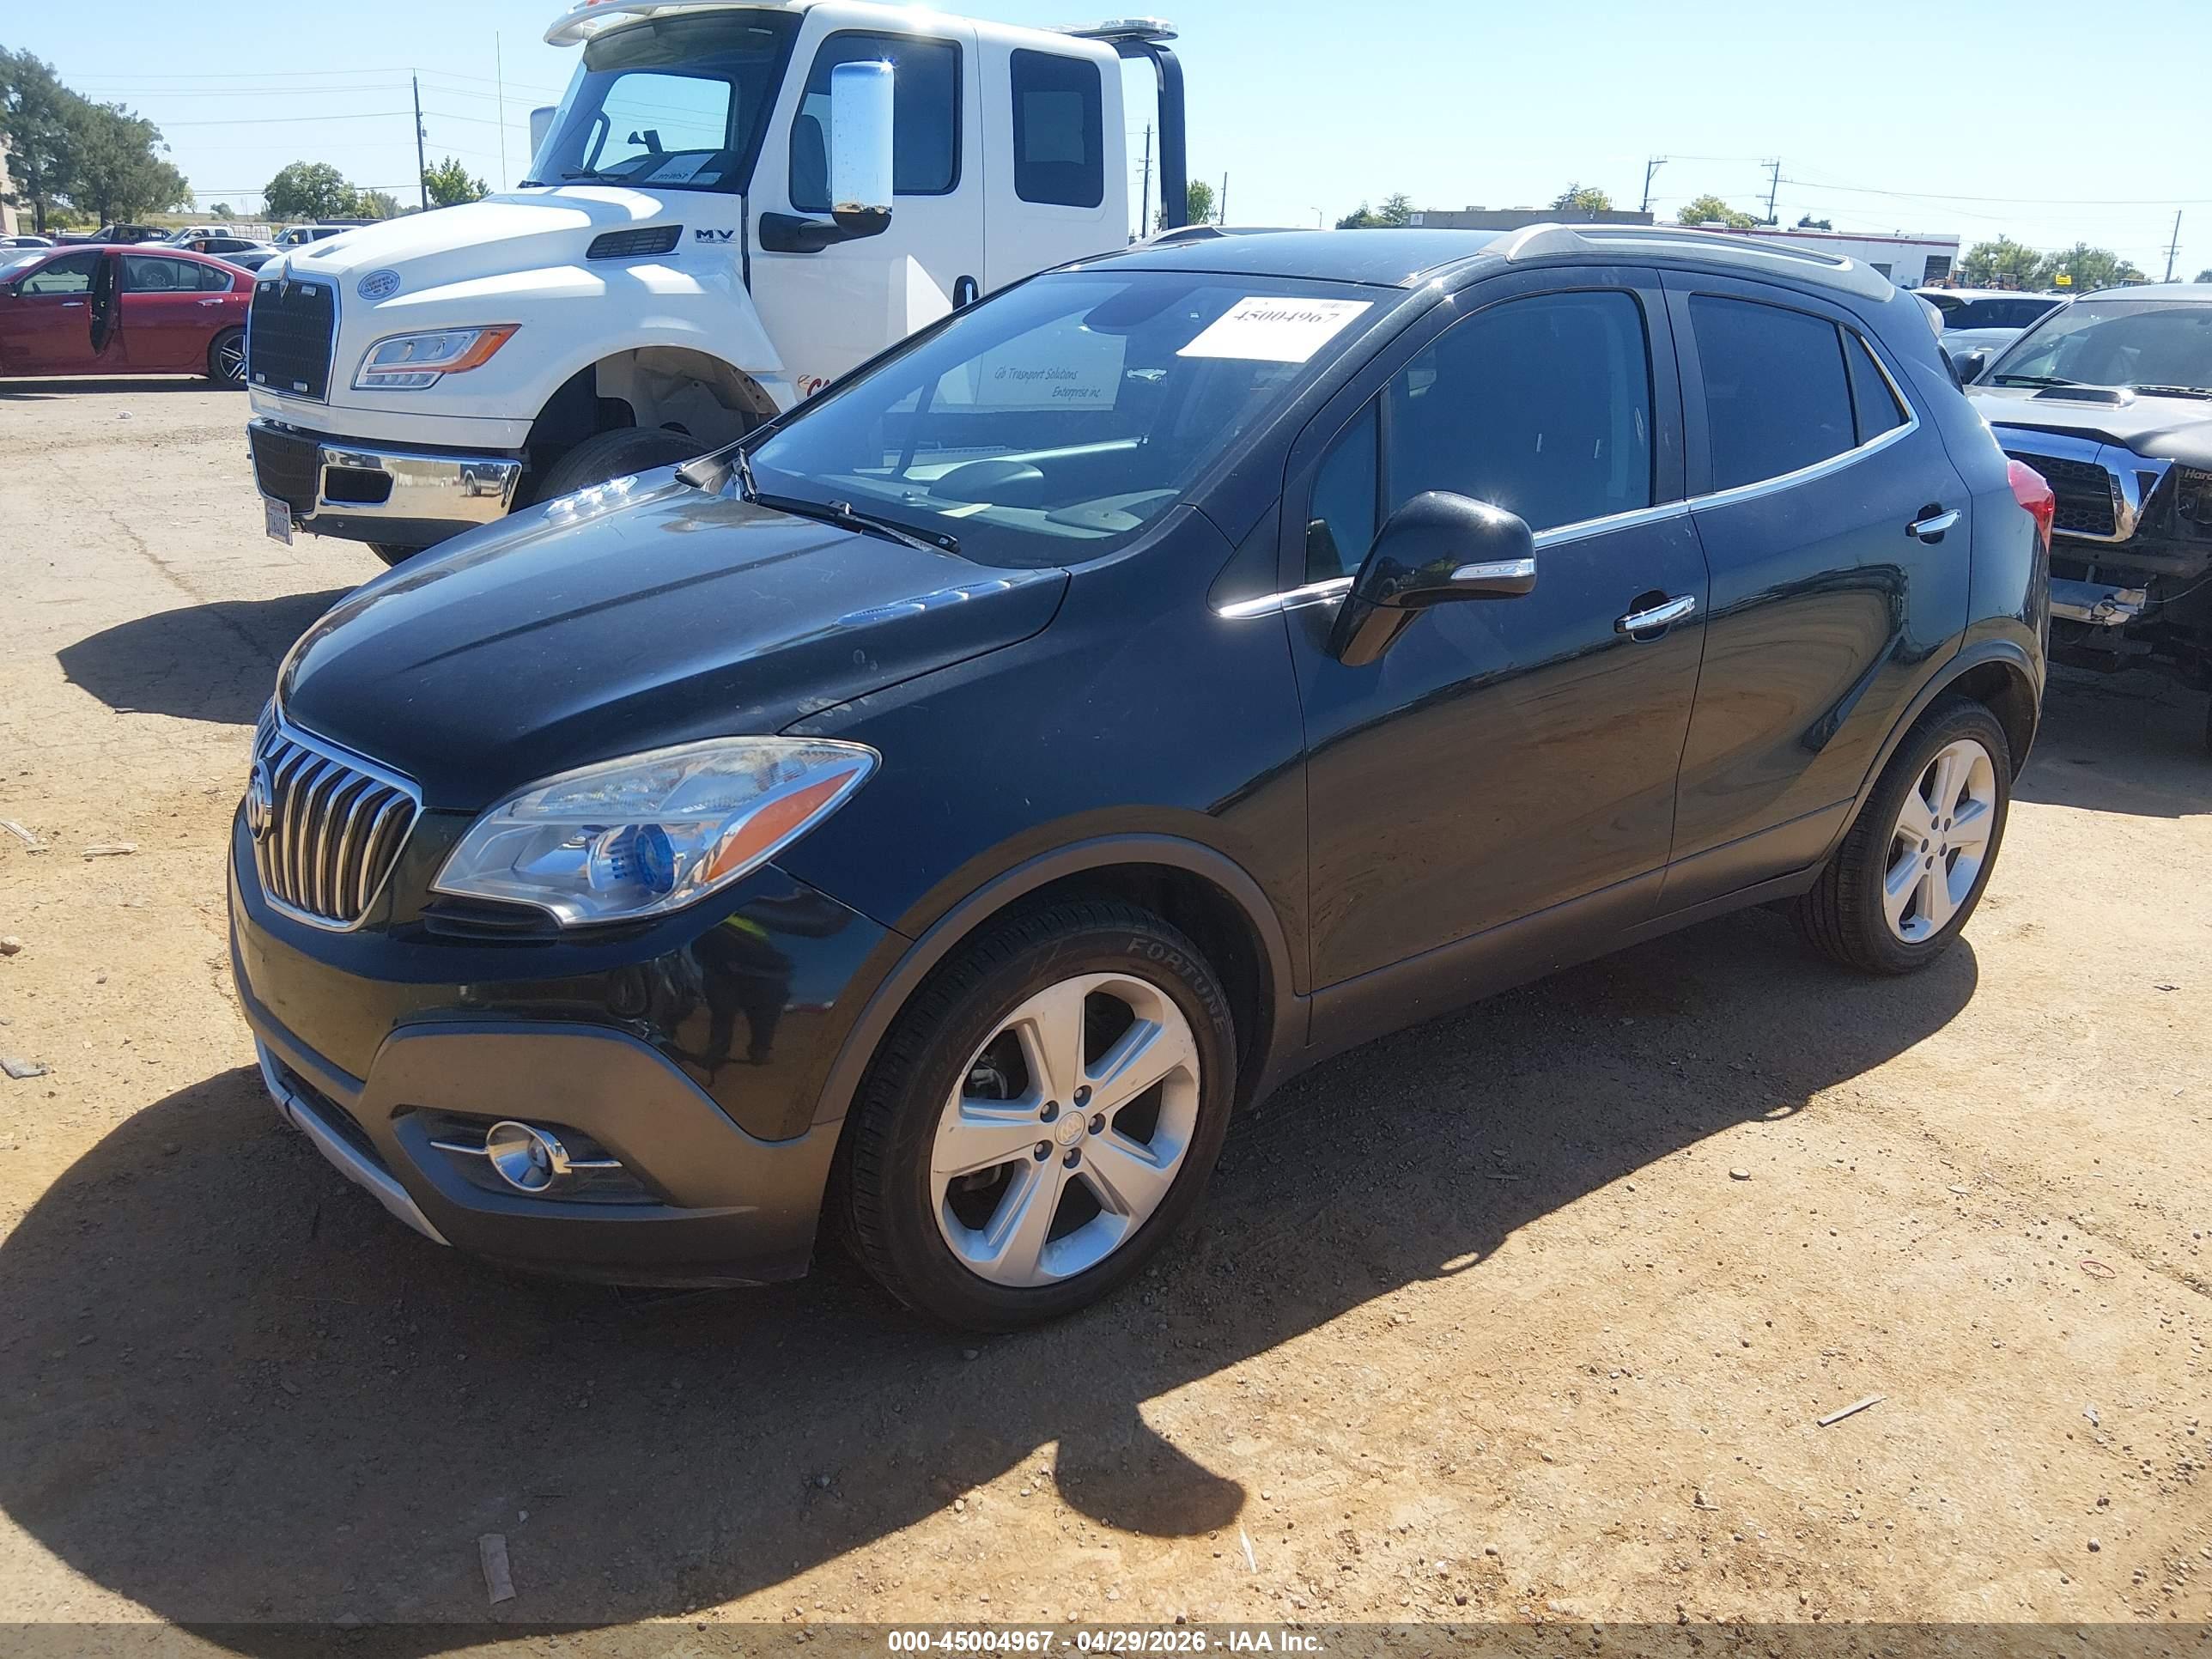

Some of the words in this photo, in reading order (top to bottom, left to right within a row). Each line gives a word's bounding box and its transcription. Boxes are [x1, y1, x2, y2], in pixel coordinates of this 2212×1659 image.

[696, 229, 735, 240] MV
[1233, 309, 1340, 324] 45004967
[1045, 366, 1079, 380] Solutions
[1052, 386, 1089, 401] Enterprise
[1126, 937, 1225, 1033] FORTUNE
